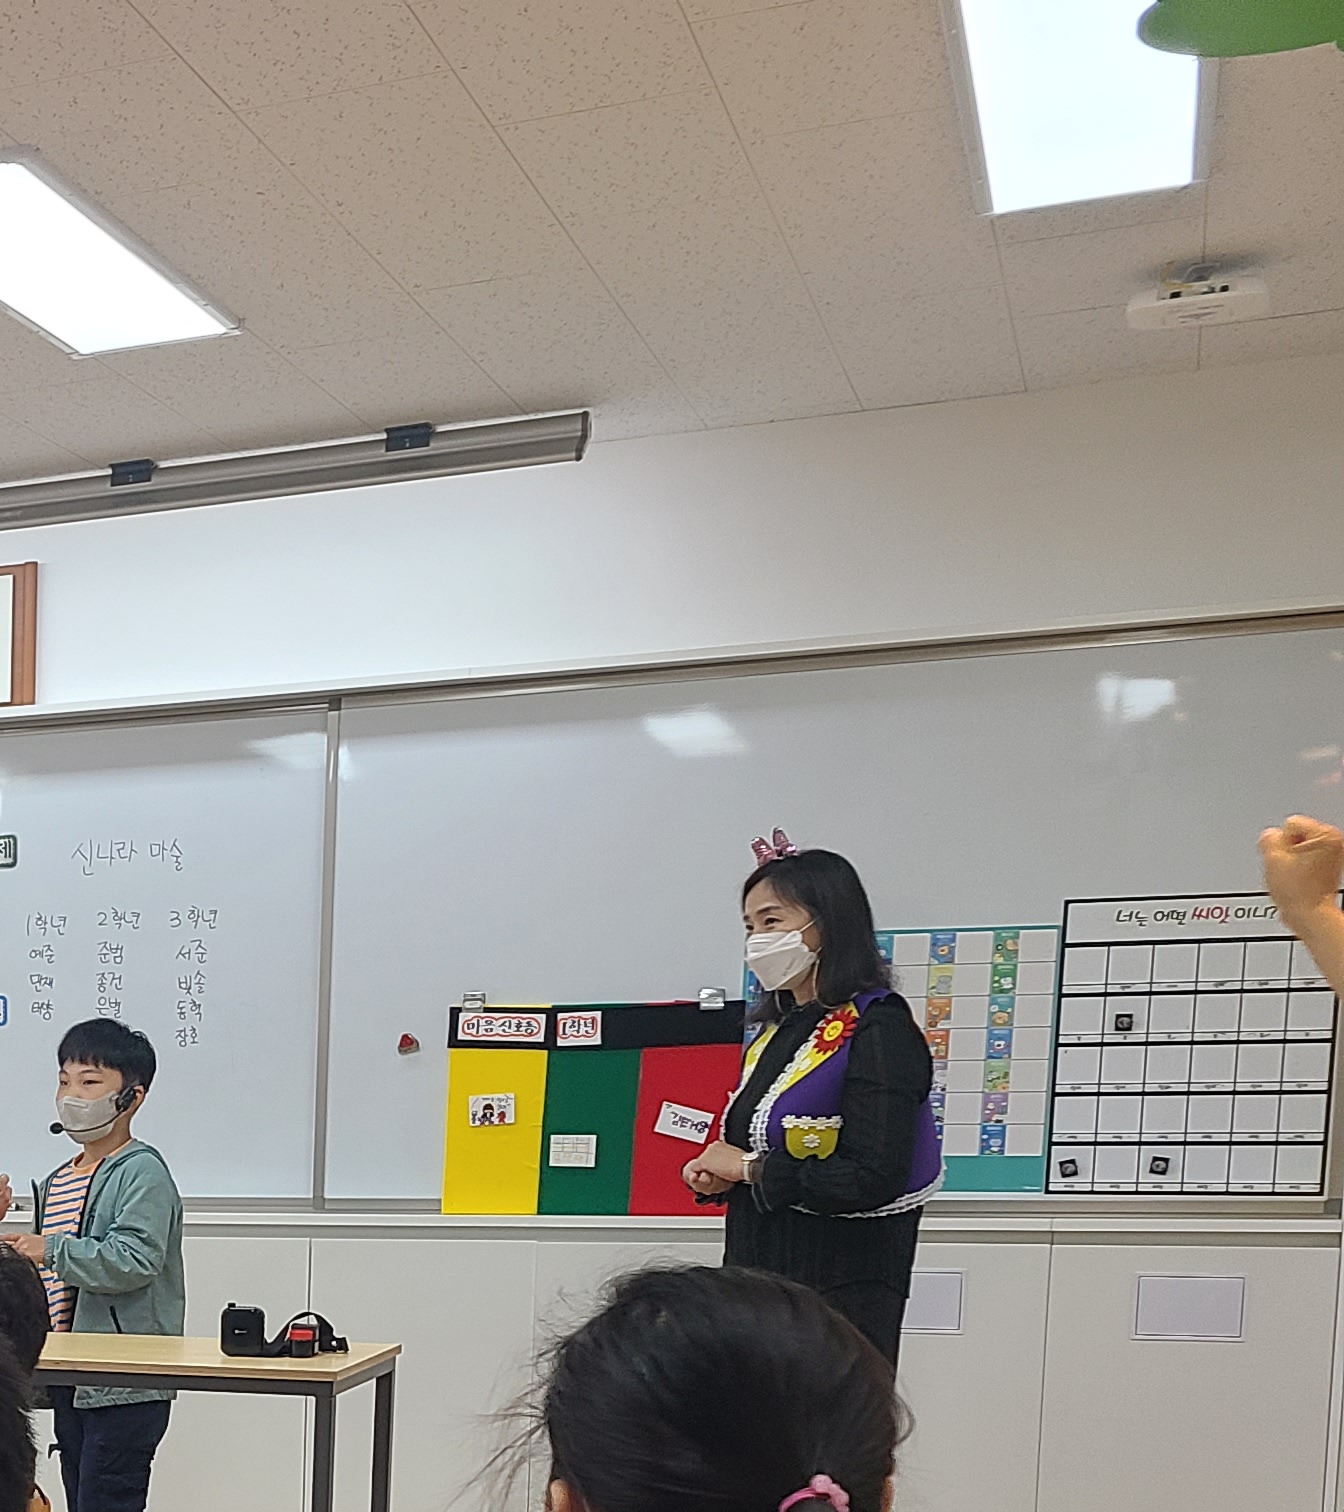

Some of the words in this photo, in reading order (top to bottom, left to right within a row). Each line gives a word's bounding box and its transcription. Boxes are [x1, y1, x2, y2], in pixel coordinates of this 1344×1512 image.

[149, 838, 184, 872] 마술
[1115, 909, 1149, 927] 너는
[1191, 906, 1230, 924] 씨앗
[28, 944, 56, 964] 예준
[97, 940, 124, 965] 준범
[175, 939, 208, 964] 서준
[95, 971, 123, 993] 종건
[31, 999, 54, 1021] 태양
[176, 998, 202, 1022] 동혁
[175, 1025, 199, 1048] 장호
